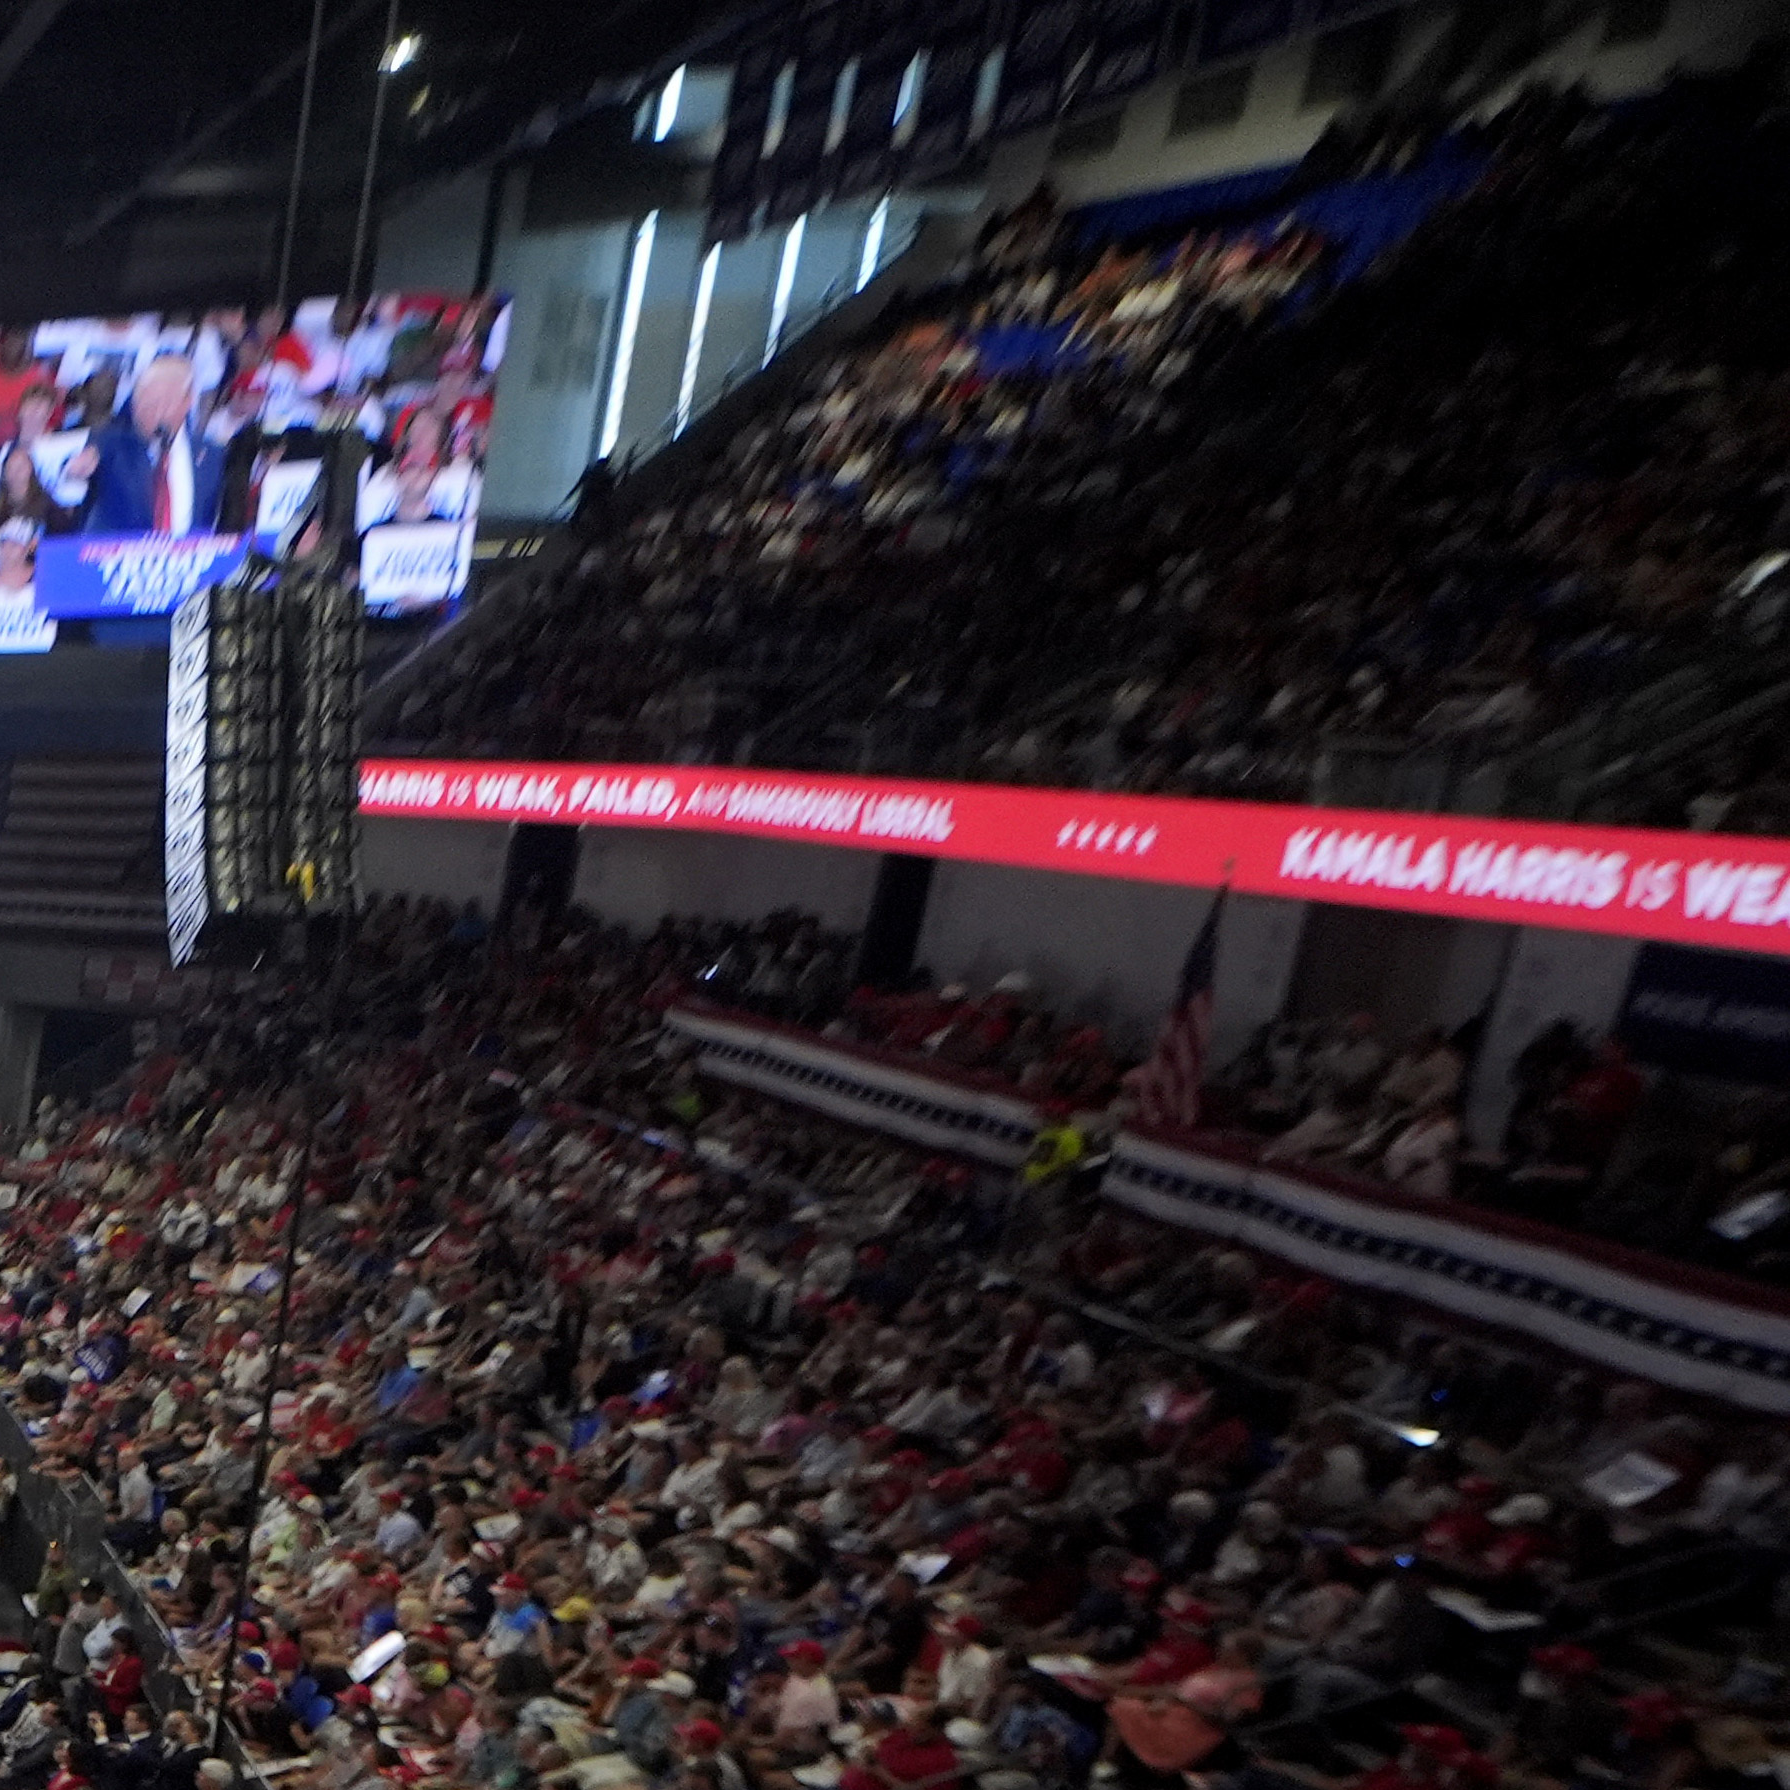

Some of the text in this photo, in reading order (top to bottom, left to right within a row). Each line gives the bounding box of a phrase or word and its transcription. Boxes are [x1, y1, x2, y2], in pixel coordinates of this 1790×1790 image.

[475, 772, 566, 818] WEAK,
[567, 775, 683, 823] FAILED,
[1280, 827, 1449, 893] KAMALA
[1448, 839, 1629, 909] HARRIS
[1625, 859, 1684, 911] IS
